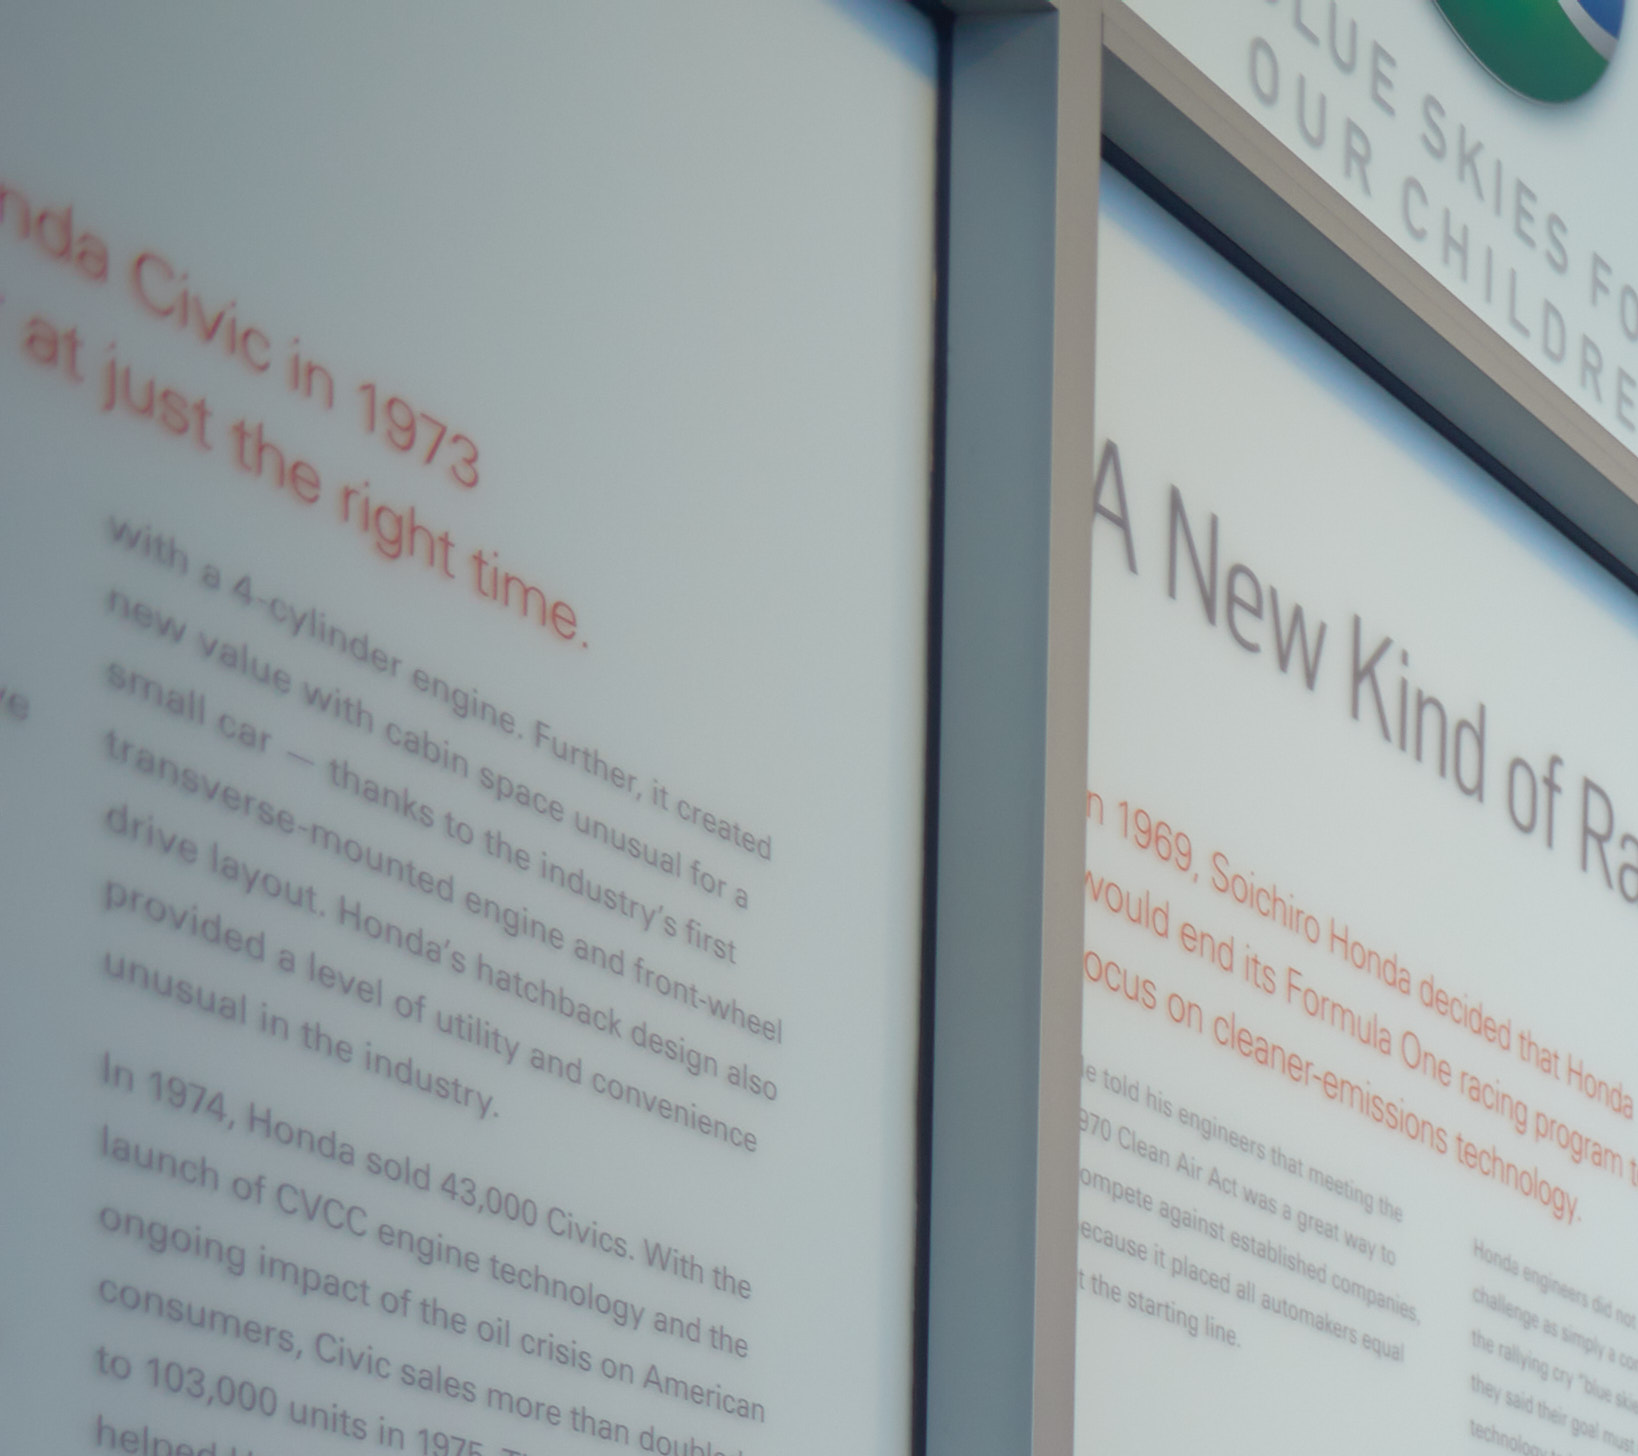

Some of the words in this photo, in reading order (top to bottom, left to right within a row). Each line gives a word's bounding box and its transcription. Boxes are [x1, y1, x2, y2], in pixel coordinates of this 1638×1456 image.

[1249, 36, 1372, 198] OUR
[1265, 0, 1397, 117] LUE
[1419, 94, 1569, 276] SKIES
[21, 316, 83, 382] at
[102, 343, 211, 450] just
[230, 420, 321, 505] the
[339, 482, 454, 578] right
[469, 550, 587, 647] time.
[130, 252, 270, 373] Civic
[289, 338, 334, 408] in
[358, 382, 479, 488] 1973
[108, 517, 188, 574] with
[200, 564, 221, 590] a
[231, 576, 402, 677] 4-cylinder
[409, 669, 522, 739] engine.
[533, 720, 642, 801] Further,
[651, 779, 668, 811] it
[676, 800, 771, 861] created
[1094, 438, 1137, 574] A
[1166, 484, 1326, 691] New
[1350, 614, 1486, 803] Kind
[1506, 754, 1563, 849] of
[1118, 803, 1198, 882] 1969,
[1211, 851, 1320, 944] Soichiro
[1329, 919, 1411, 995] Honda
[1418, 976, 1511, 1051] decided
[1517, 1031, 1559, 1079] that
[1566, 1054, 1633, 1119] Honda
[101, 1052, 134, 1091] In
[149, 1071, 234, 1130] 1974,
[246, 1102, 355, 1167] Honda
[365, 1152, 430, 1192] sold
[439, 1172, 538, 1227] 43,000
[546, 1207, 634, 1260] Civics.
[643, 1239, 704, 1284] With
[712, 1266, 751, 1299] the
